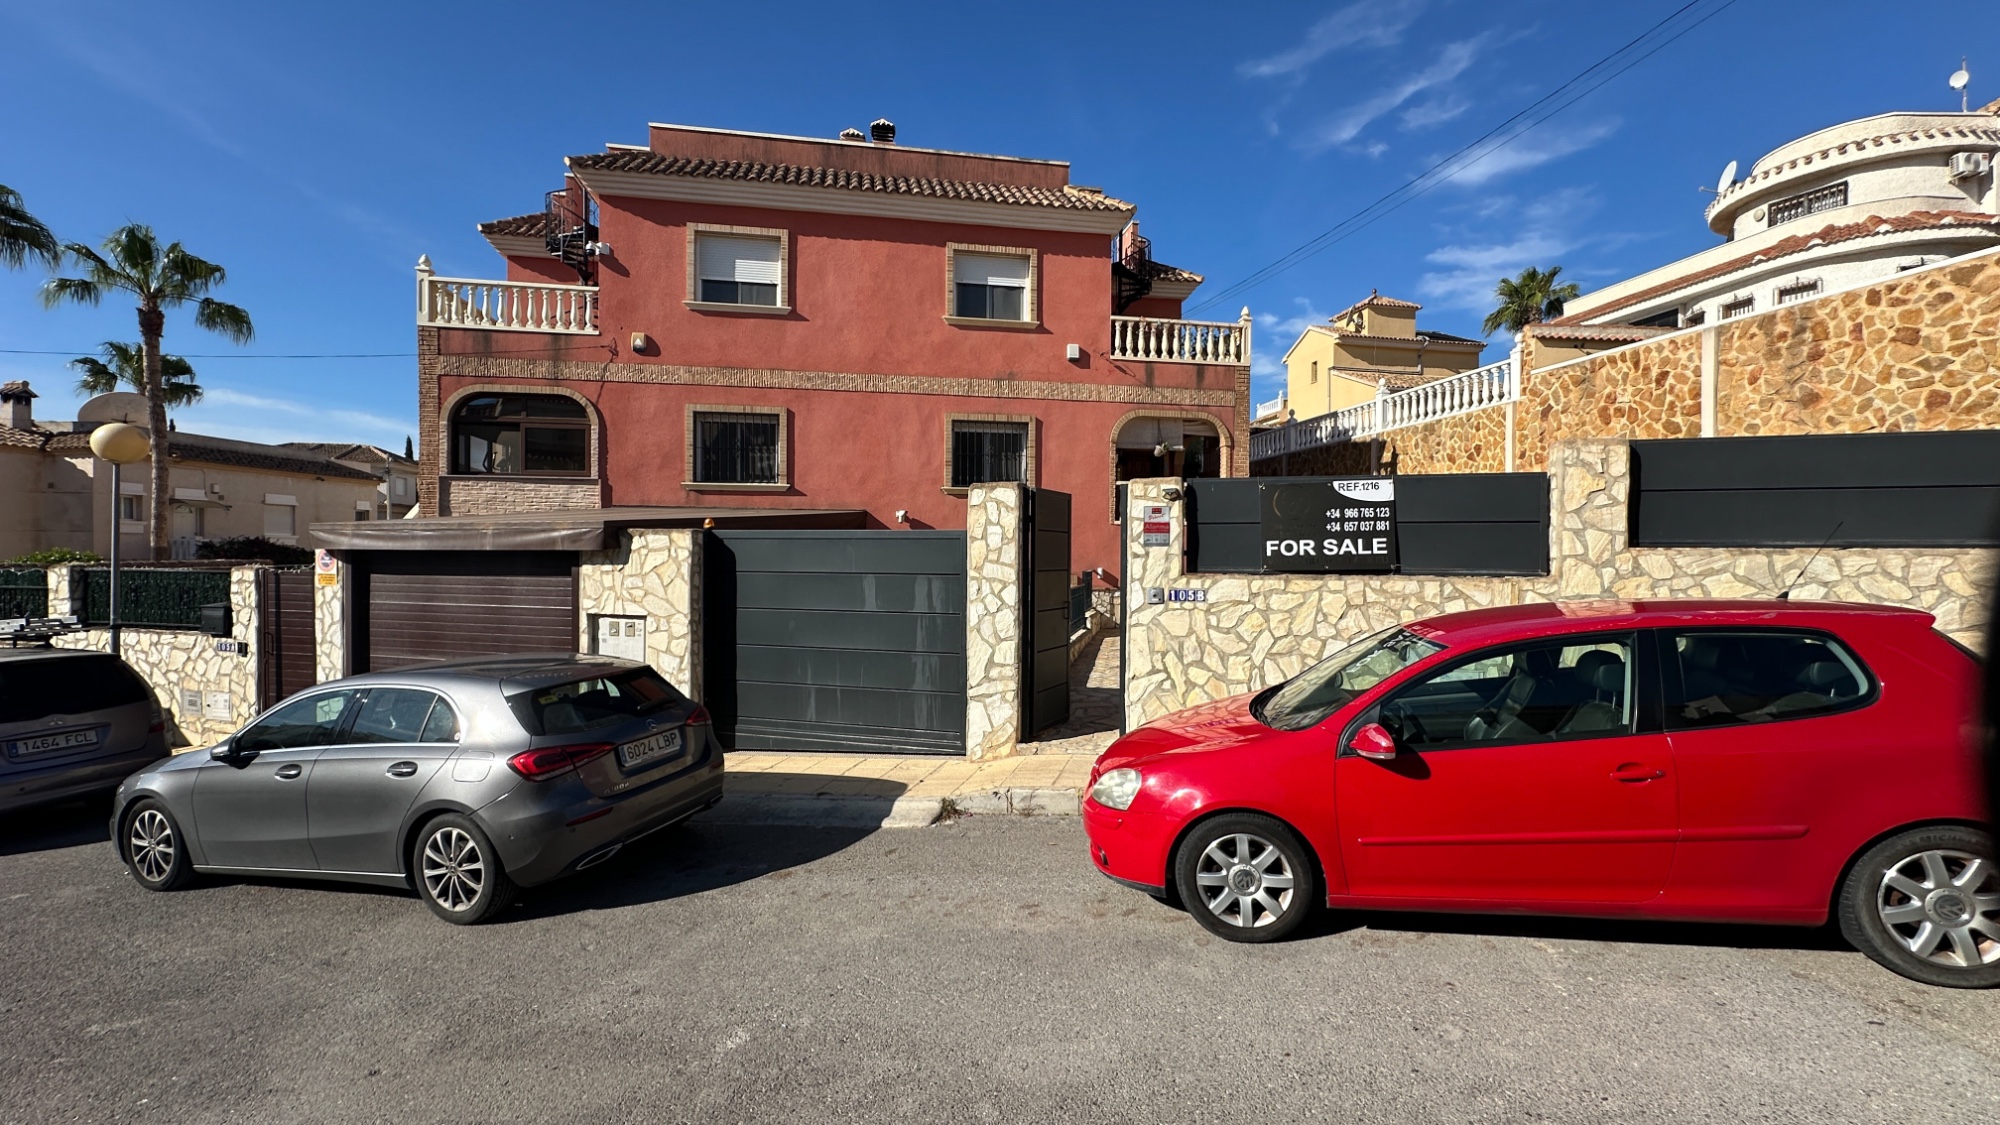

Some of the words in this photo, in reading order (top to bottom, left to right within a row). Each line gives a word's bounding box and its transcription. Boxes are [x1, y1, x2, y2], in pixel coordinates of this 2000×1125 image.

[1338, 481, 1380, 492] REF.1216
[1325, 508, 1340, 519] +34
[1343, 508, 1358, 519] 966
[1360, 507, 1374, 518] 765
[1375, 507, 1390, 518] 123
[1325, 521, 1340, 532] +34
[1343, 521, 1358, 532] 657
[1360, 521, 1374, 531] 037
[1375, 520, 1390, 531] 881
[1266, 539, 1316, 557] FOR
[1322, 537, 1388, 556] SALE
[1169, 590, 1205, 601] 105B
[23, 738, 60, 752] 1464
[65, 732, 94, 745] FCL
[626, 740, 655, 760] 6024
[656, 732, 677, 750] LBP
